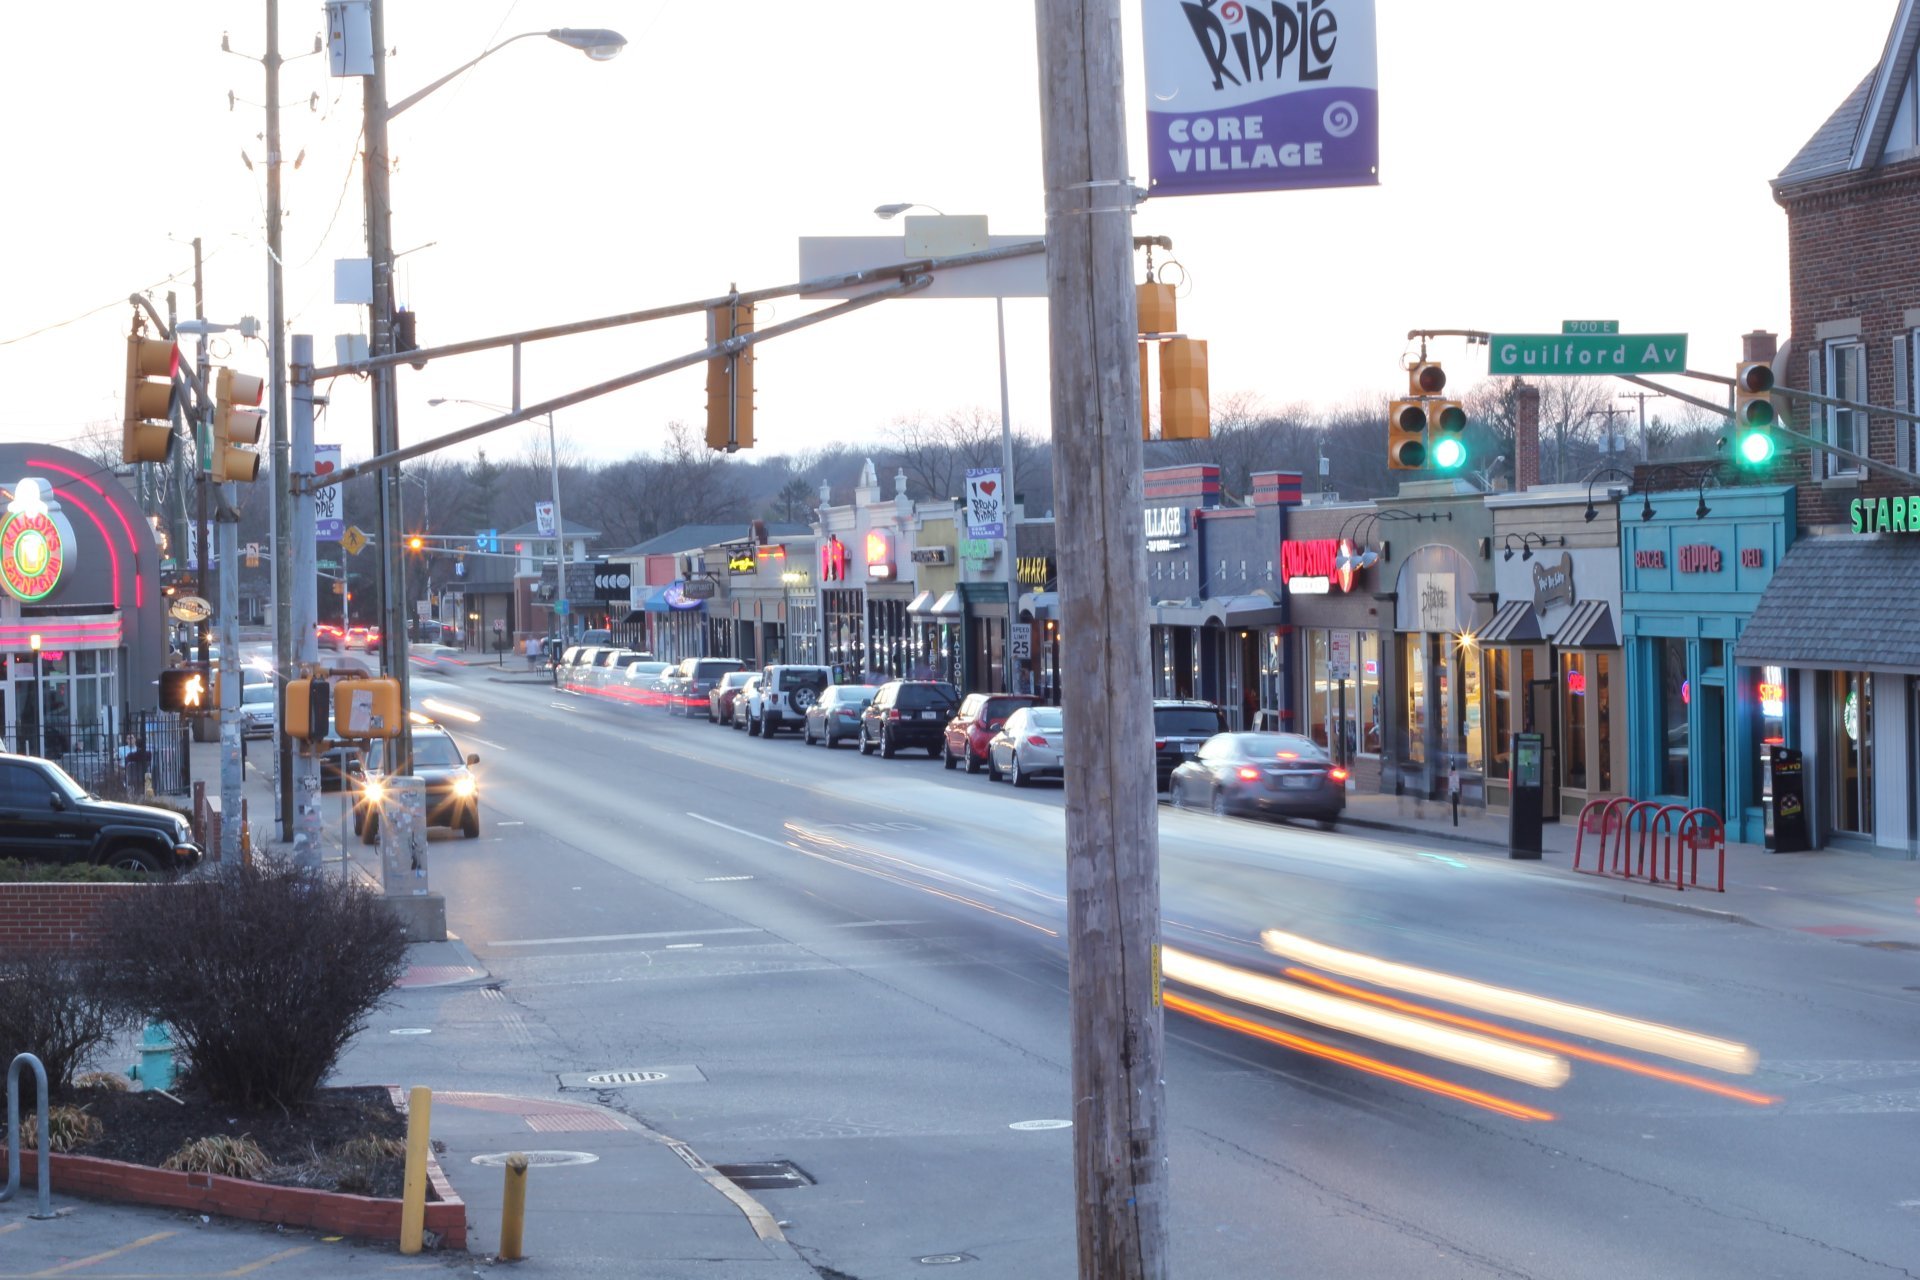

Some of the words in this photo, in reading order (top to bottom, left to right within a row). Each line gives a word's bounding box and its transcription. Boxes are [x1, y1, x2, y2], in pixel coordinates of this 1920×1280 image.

[1168, 116, 1263, 143] CORE
[1168, 143, 1323, 172] VILLAGE
[1571, 321, 1597, 332] 900
[1603, 321, 1611, 332] E
[1500, 343, 1625, 365] Guilford
[1641, 343, 1677, 363] Av
[1144, 507, 1181, 537] ILLAGE
[1850, 496, 1920, 534] STARB
[1281, 540, 1305, 585] COLD
[1306, 539, 1338, 584] STONE
[1635, 550, 1666, 569] BAGEL
[1678, 545, 1722, 573] Ripple
[1741, 548, 1763, 568] DELI
[1012, 641, 1029, 655] 25
